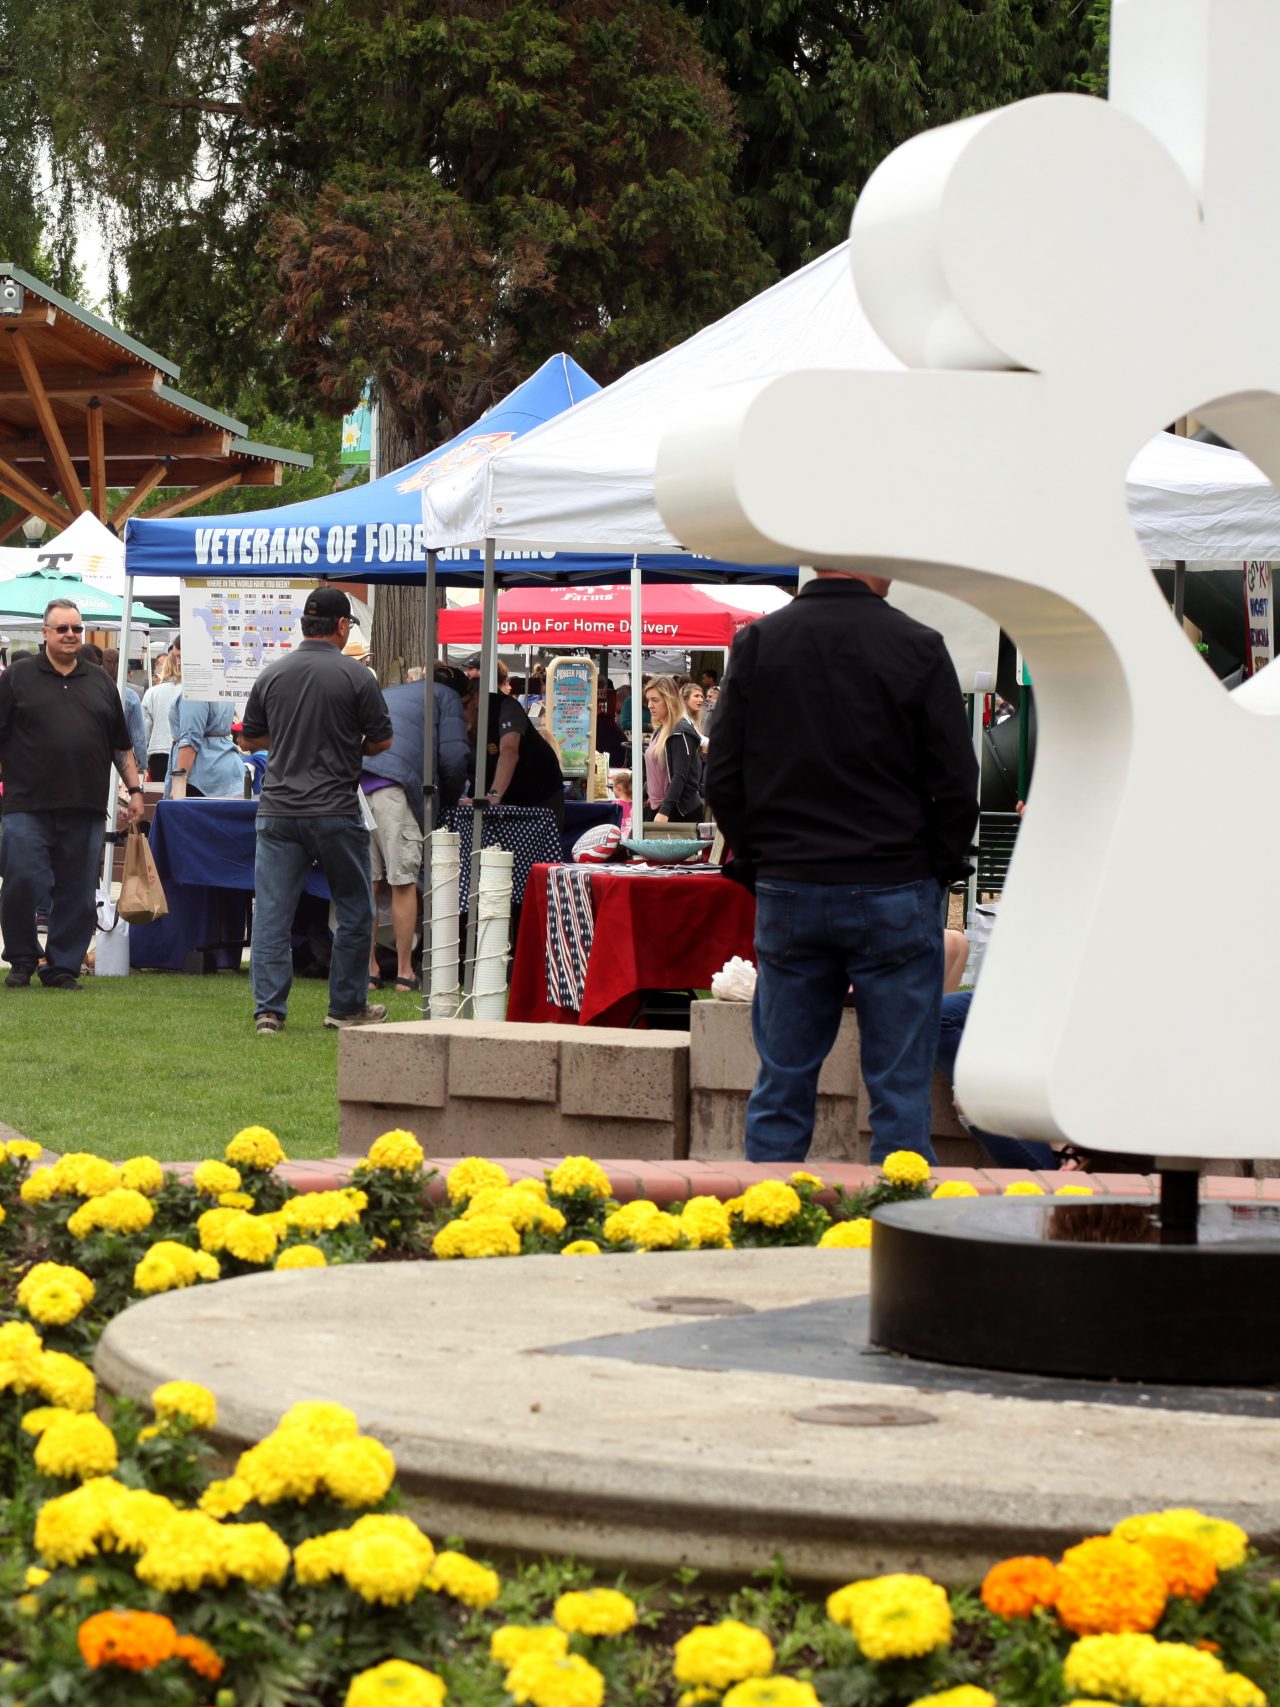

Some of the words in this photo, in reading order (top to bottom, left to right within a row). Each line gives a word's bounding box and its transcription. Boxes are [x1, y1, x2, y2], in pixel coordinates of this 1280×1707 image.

[195, 526, 320, 565] VETERANS
[326, 525, 358, 564] OF
[497, 618, 518, 634] ign
[521, 618, 541, 634] Up
[545, 618, 570, 632] For
[574, 618, 615, 632] Home
